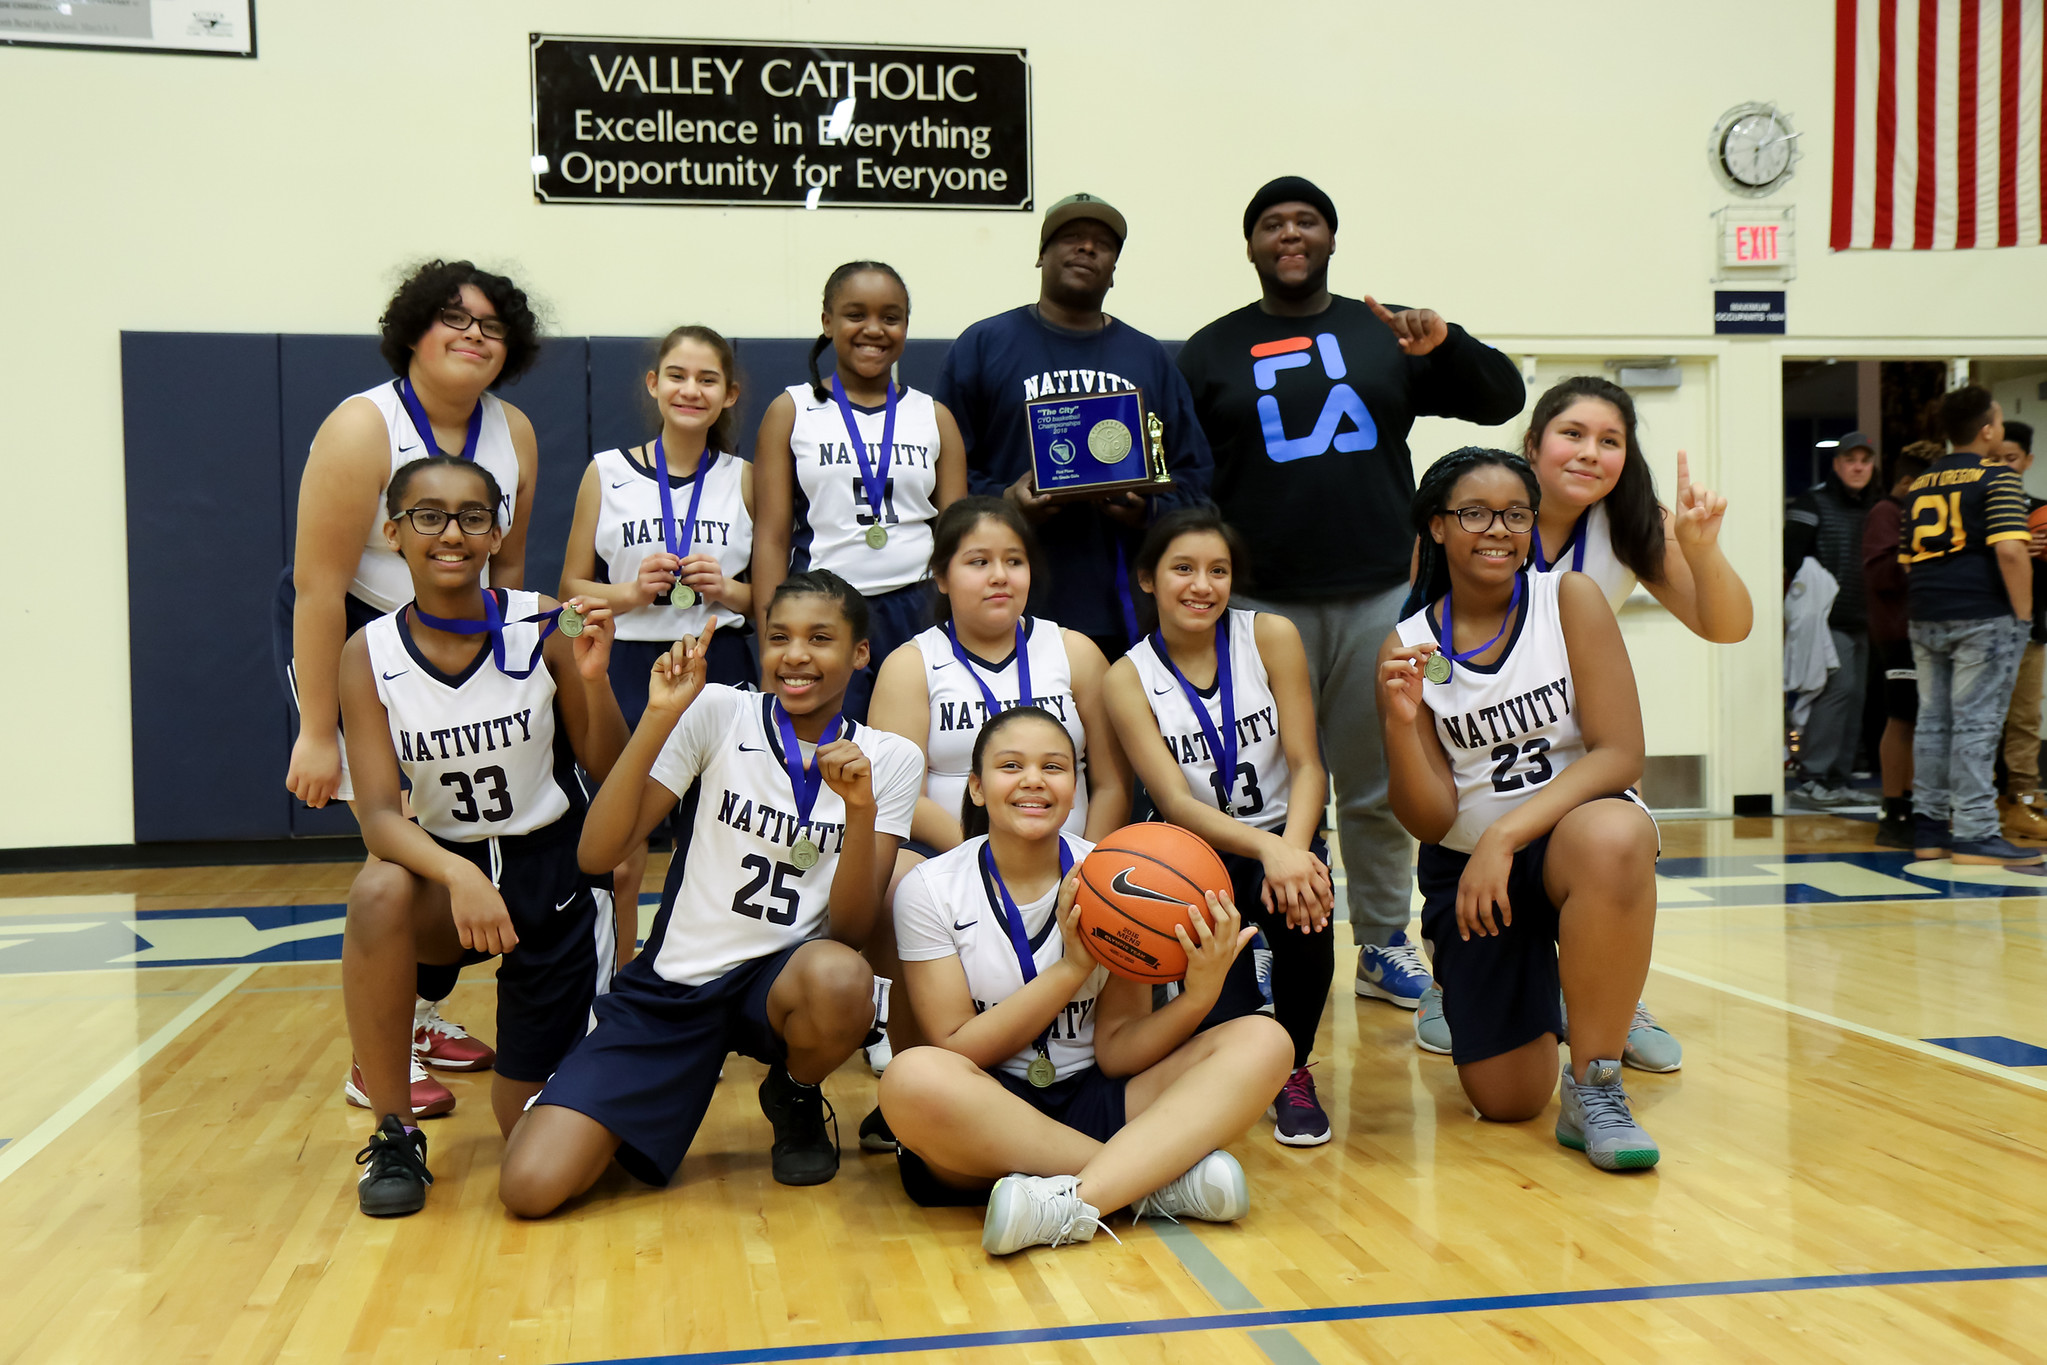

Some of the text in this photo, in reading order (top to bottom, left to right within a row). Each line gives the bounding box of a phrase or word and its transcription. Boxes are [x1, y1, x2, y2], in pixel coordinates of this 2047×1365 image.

[589, 54, 977, 102] VALLEY CATHOLIC
[575, 109, 991, 159] Excellence in Everything
[560, 151, 1008, 198] Opportunity for Everyone
[1736, 226, 1779, 260] EXIT
[853, 477, 900, 526] 51
[1911, 491, 1967, 563] 21
[400, 709, 531, 761] NATIVITY
[1442, 677, 1570, 749] NATIVITY
[1209, 761, 1264, 818] 13
[1491, 737, 1553, 793] 23
[440, 765, 514, 823] 33
[731, 853, 806, 926] 25
[1117, 931, 1141, 947] MENS
